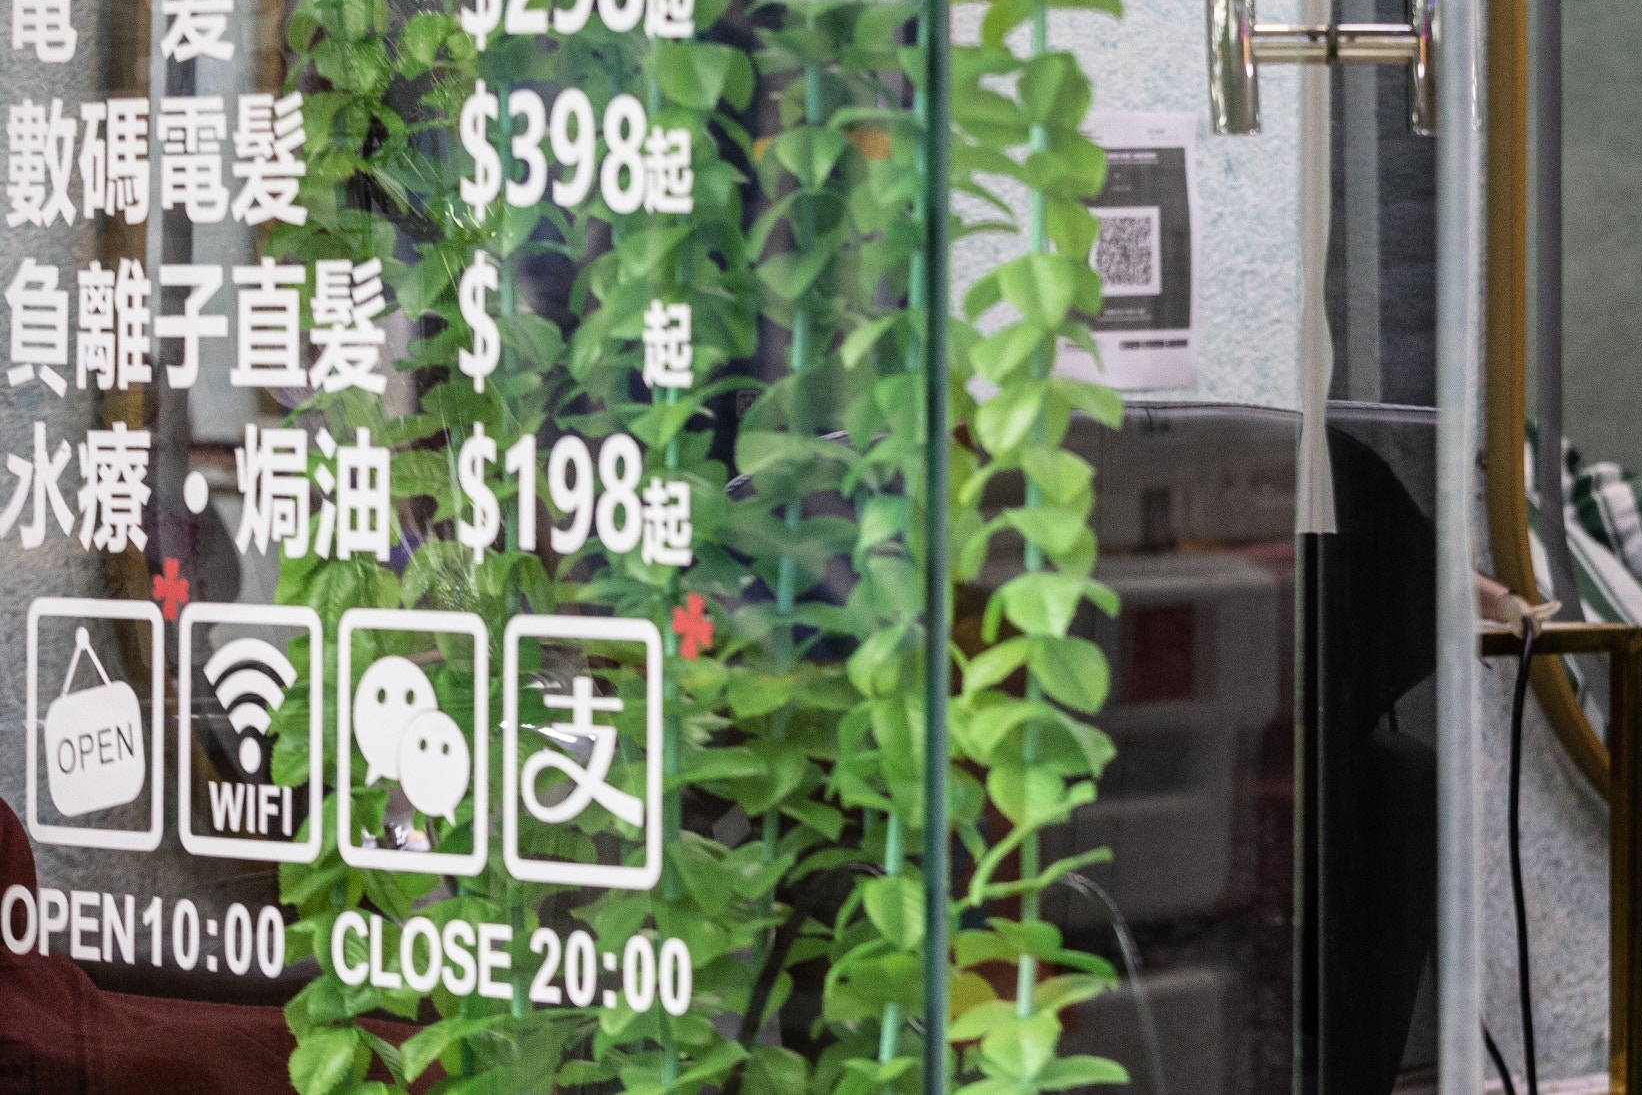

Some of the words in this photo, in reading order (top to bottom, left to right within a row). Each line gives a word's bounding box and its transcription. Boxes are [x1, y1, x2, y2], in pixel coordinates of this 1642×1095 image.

[5, 90, 308, 229] 數碼電髮
[4, 257, 388, 398] 負離子直髮
[642, 300, 693, 389] 起
[57, 722, 135, 774] OPEN
[208, 781, 292, 836] WIFI
[521, 675, 644, 828] 支
[331, 910, 513, 1000] CLOSE
[529, 927, 693, 1016] 20:00
